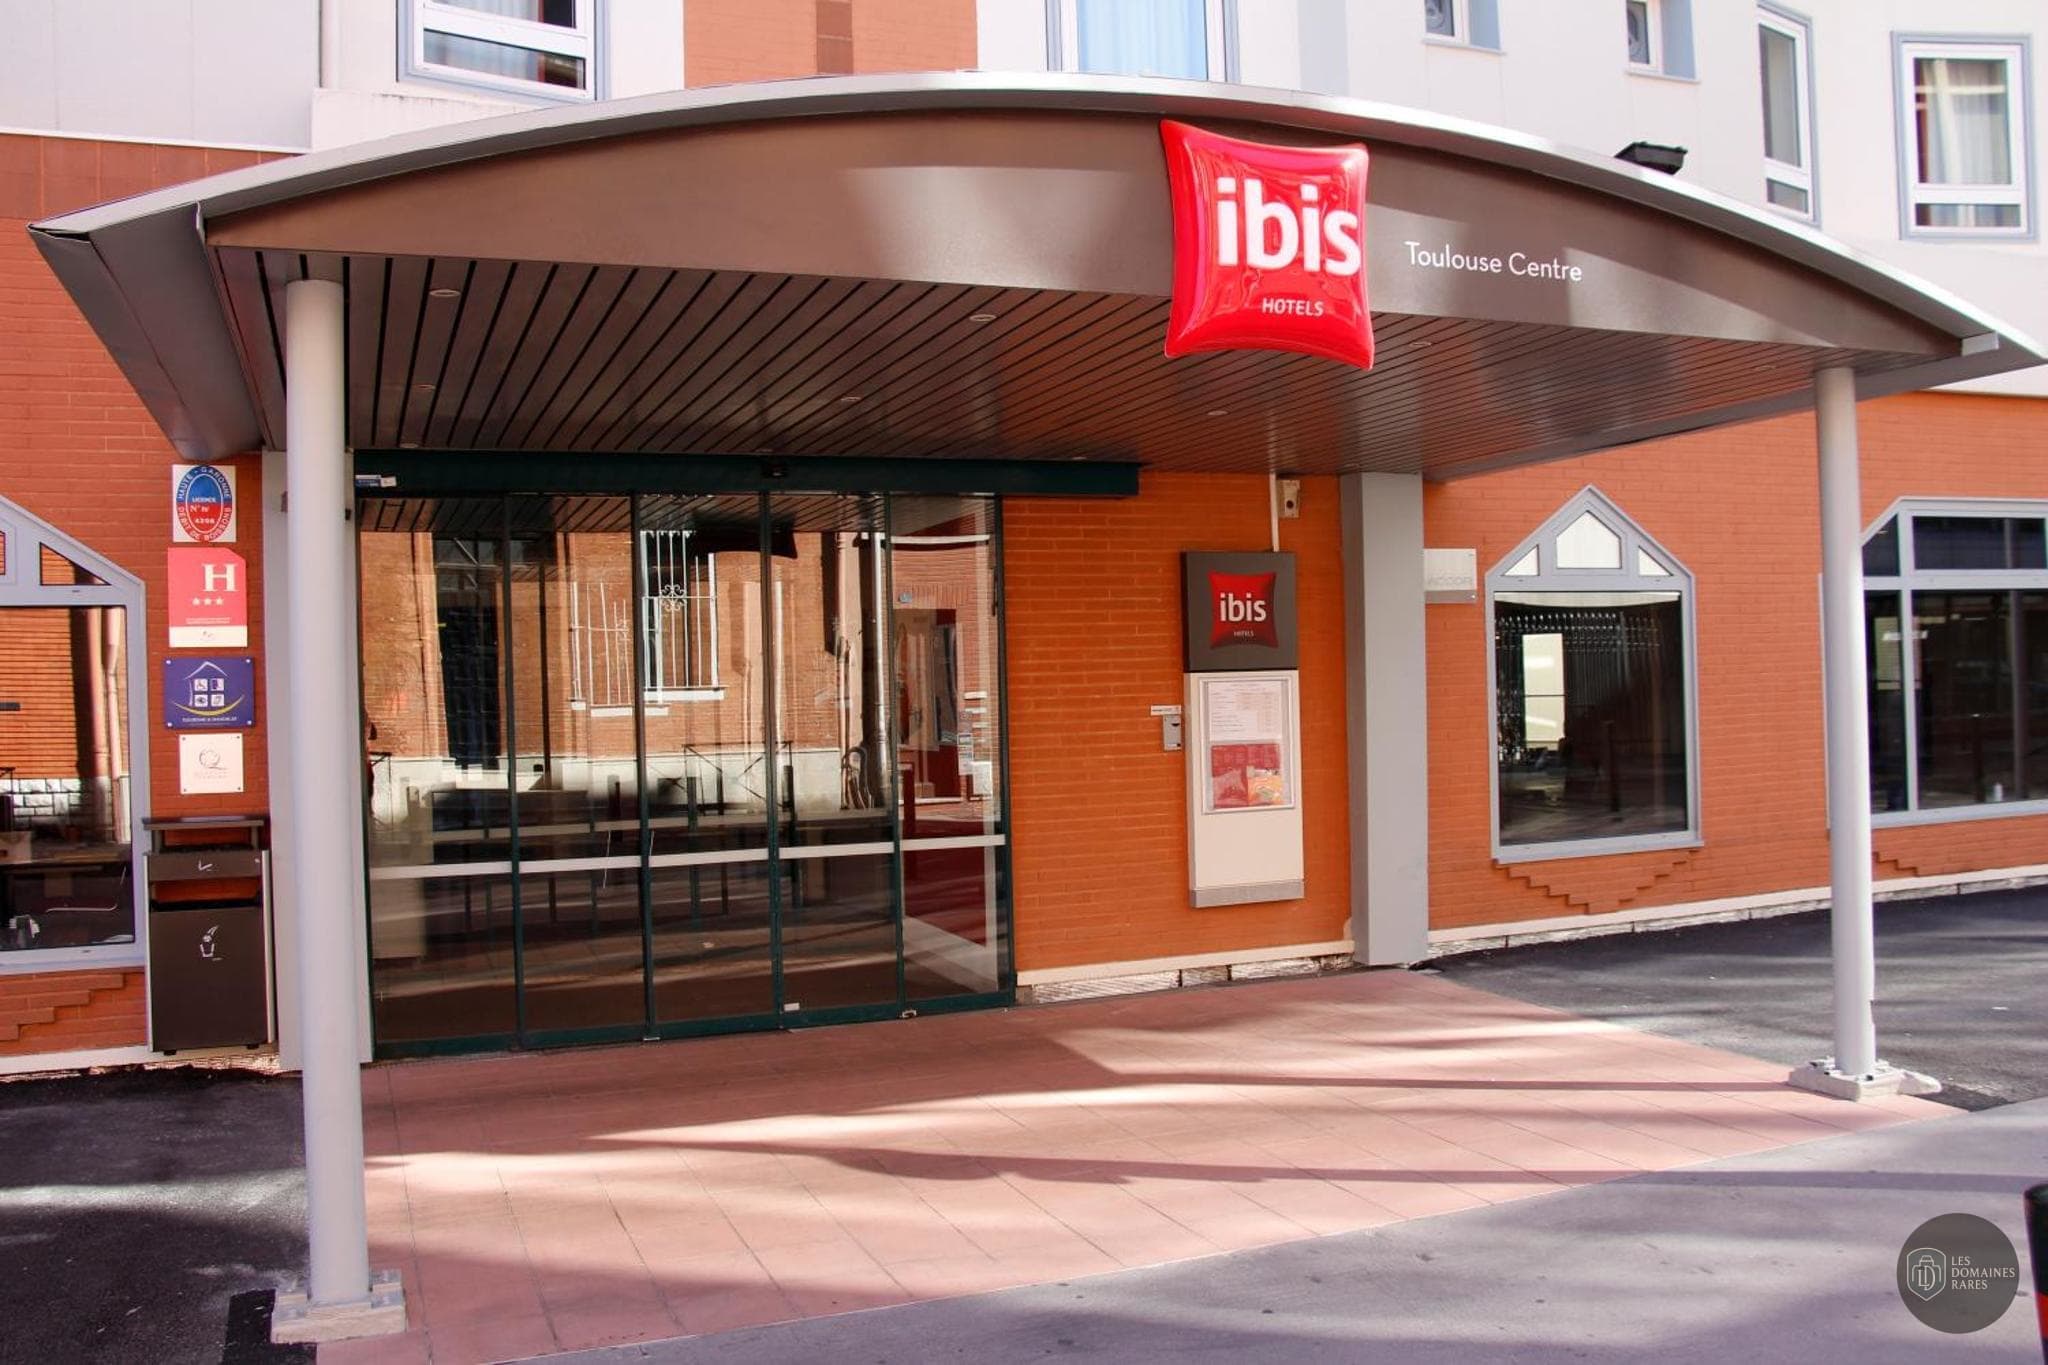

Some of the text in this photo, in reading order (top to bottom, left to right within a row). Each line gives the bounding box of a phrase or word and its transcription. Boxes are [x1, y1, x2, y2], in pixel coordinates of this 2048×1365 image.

[1217, 176, 1361, 276] ibis
[1404, 241, 1582, 281] Toulouse Centre
[1262, 298, 1324, 316] HOTELS
[201, 564, 240, 592] H
[1220, 592, 1267, 622] ibis
